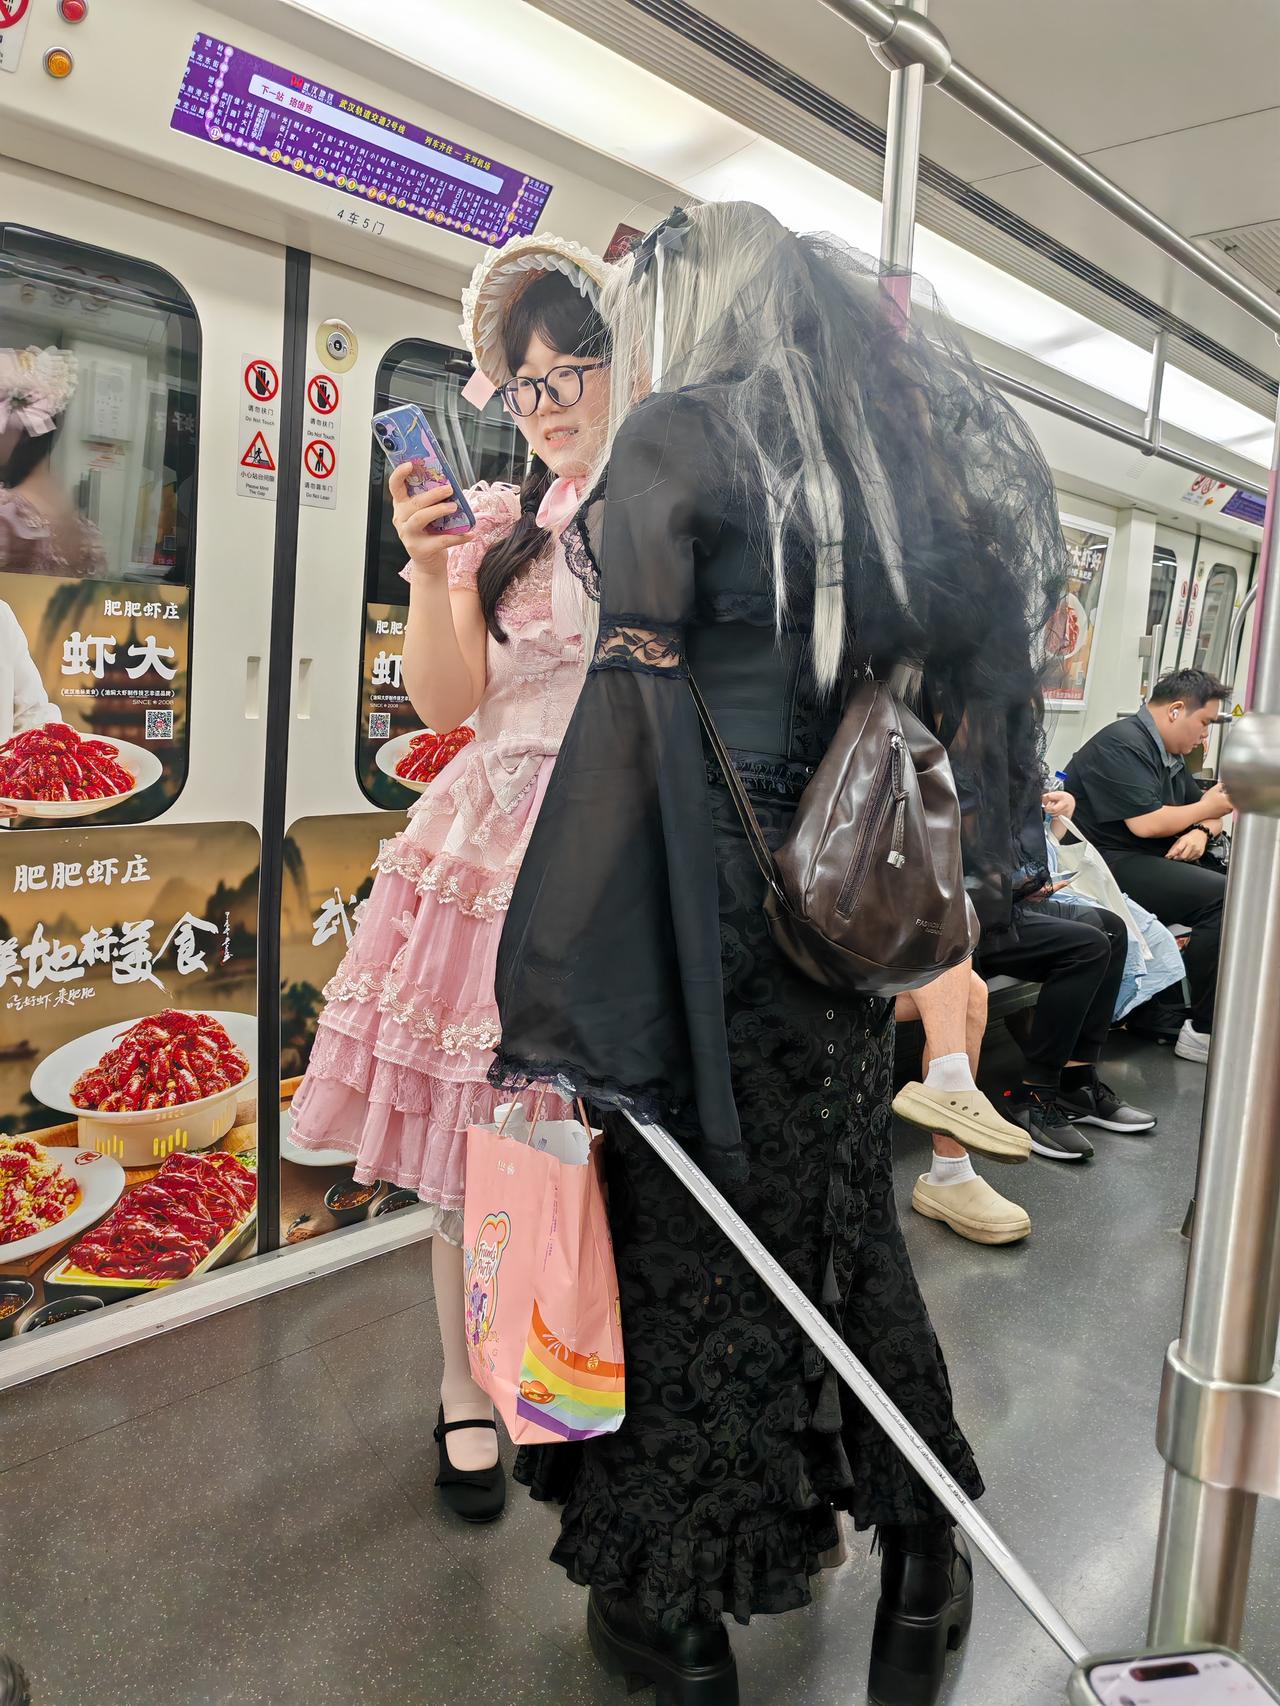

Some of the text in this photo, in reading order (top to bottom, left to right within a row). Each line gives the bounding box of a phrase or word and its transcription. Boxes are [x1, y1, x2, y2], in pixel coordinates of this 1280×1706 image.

[260, 84, 284, 102] 下一站
[338, 97, 406, 135] 武汉轨道交通2号线
[424, 135, 491, 171] 列车开往 天河机场
[337, 209, 385, 235] 4车5门
[104, 599, 180, 620] 肥肥虾庄
[375, 620, 408, 635] 肥肥
[61, 631, 177, 681] 虾大
[13, 854, 151, 893] 肥肥虾庄
